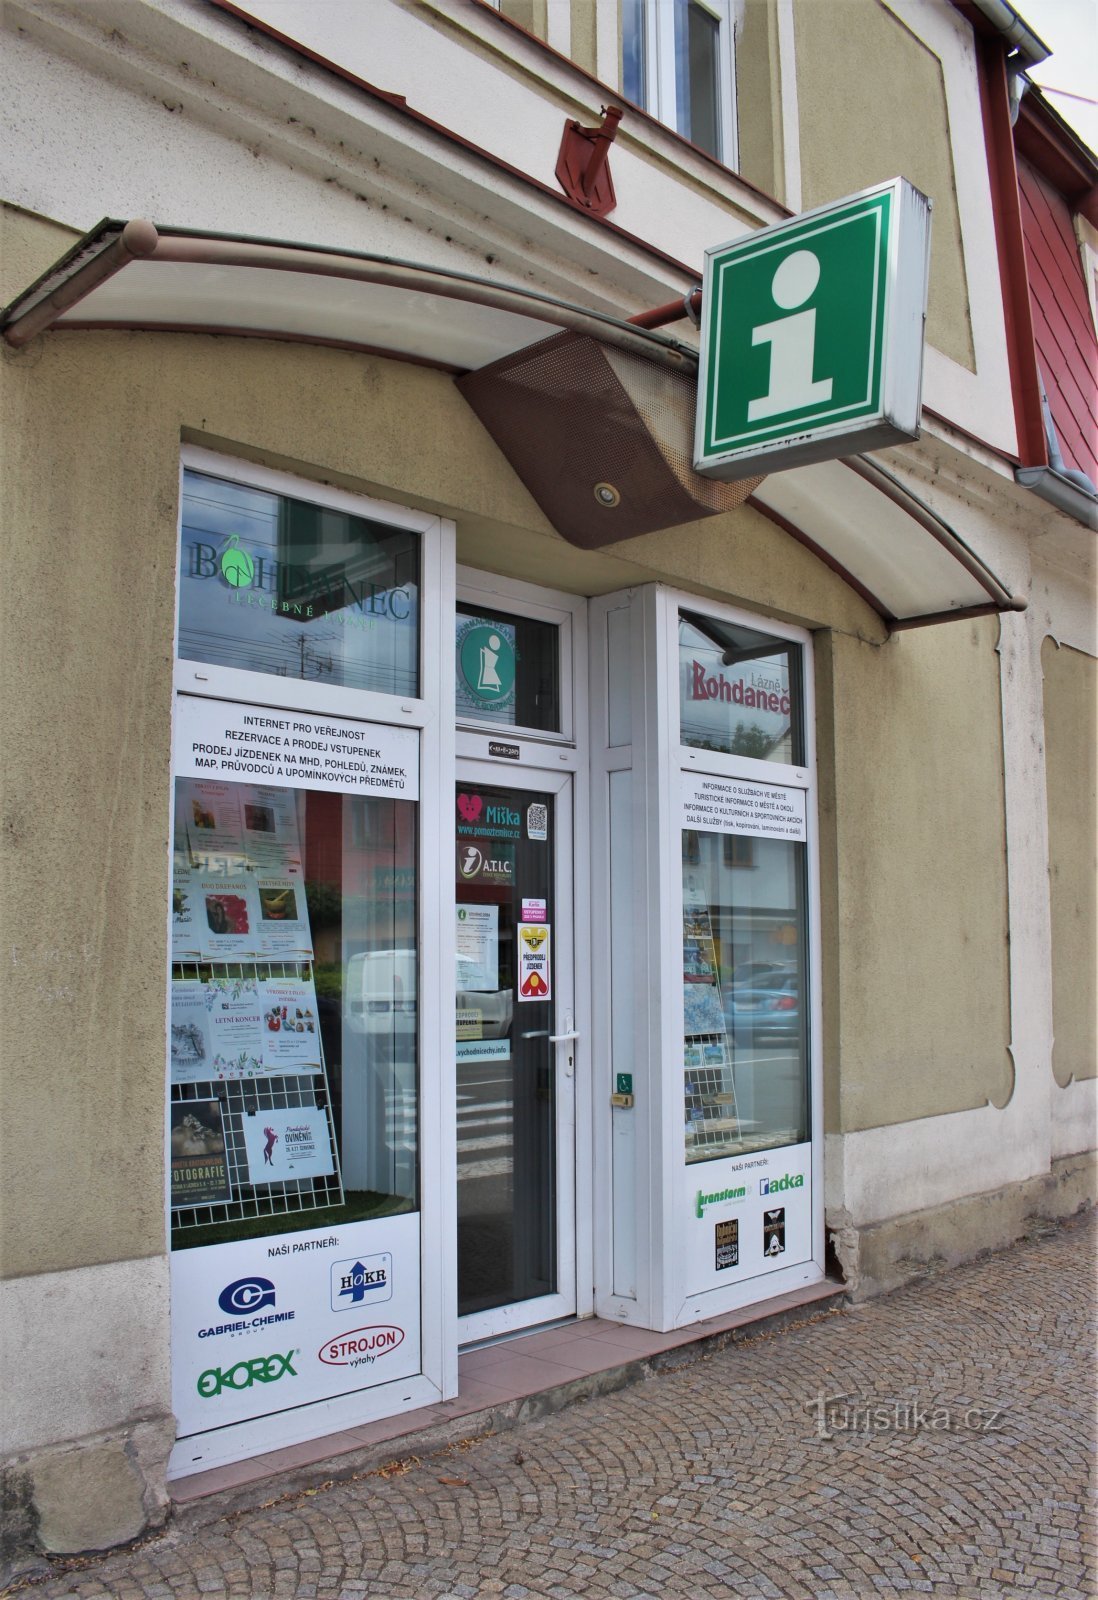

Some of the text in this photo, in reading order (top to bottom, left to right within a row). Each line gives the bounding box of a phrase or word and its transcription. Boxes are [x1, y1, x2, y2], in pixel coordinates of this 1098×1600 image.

[692, 660, 790, 715] Bohdaneč
[751, 672, 781, 693] Lázně
[244, 716, 366, 740] INTERNET PRO VEŘEJNOST
[225, 730, 381, 758] REZERVACE A PRODEJ VSTUPENEK
[192, 743, 408, 778] PRODEJ JÍZDENEK NA MHD, POHLEDŮ, ZNÁMEK,
[195, 758, 405, 790] MAP, PRŮVODCŮ A UPOMÍNKOVÝCH PŘEDMĚTŮ
[702, 782, 732, 792] INFORMACE
[738, 788, 764, 797] SLUŽBÁCH
[684, 803, 714, 813] INFORMACE
[694, 792, 724, 804] TURISTICKÉ
[725, 798, 754, 807] INFORMACE
[760, 801, 775, 810] MĚSTĚ
[486, 806, 520, 826] Miška
[703, 816, 722, 826] SLUŽBY
[732, 1158, 769, 1172] NAŠI PARTNEŘI:
[268, 1238, 340, 1258] NAŠI PARTNEŘI:
[340, 1269, 386, 1289] HOKR
[198, 1311, 295, 1338] GABRIEL-CHEMIE
[230, 1328, 265, 1338] GROUP
[330, 1331, 396, 1359] STROJON
[350, 1354, 376, 1368] výtahy
